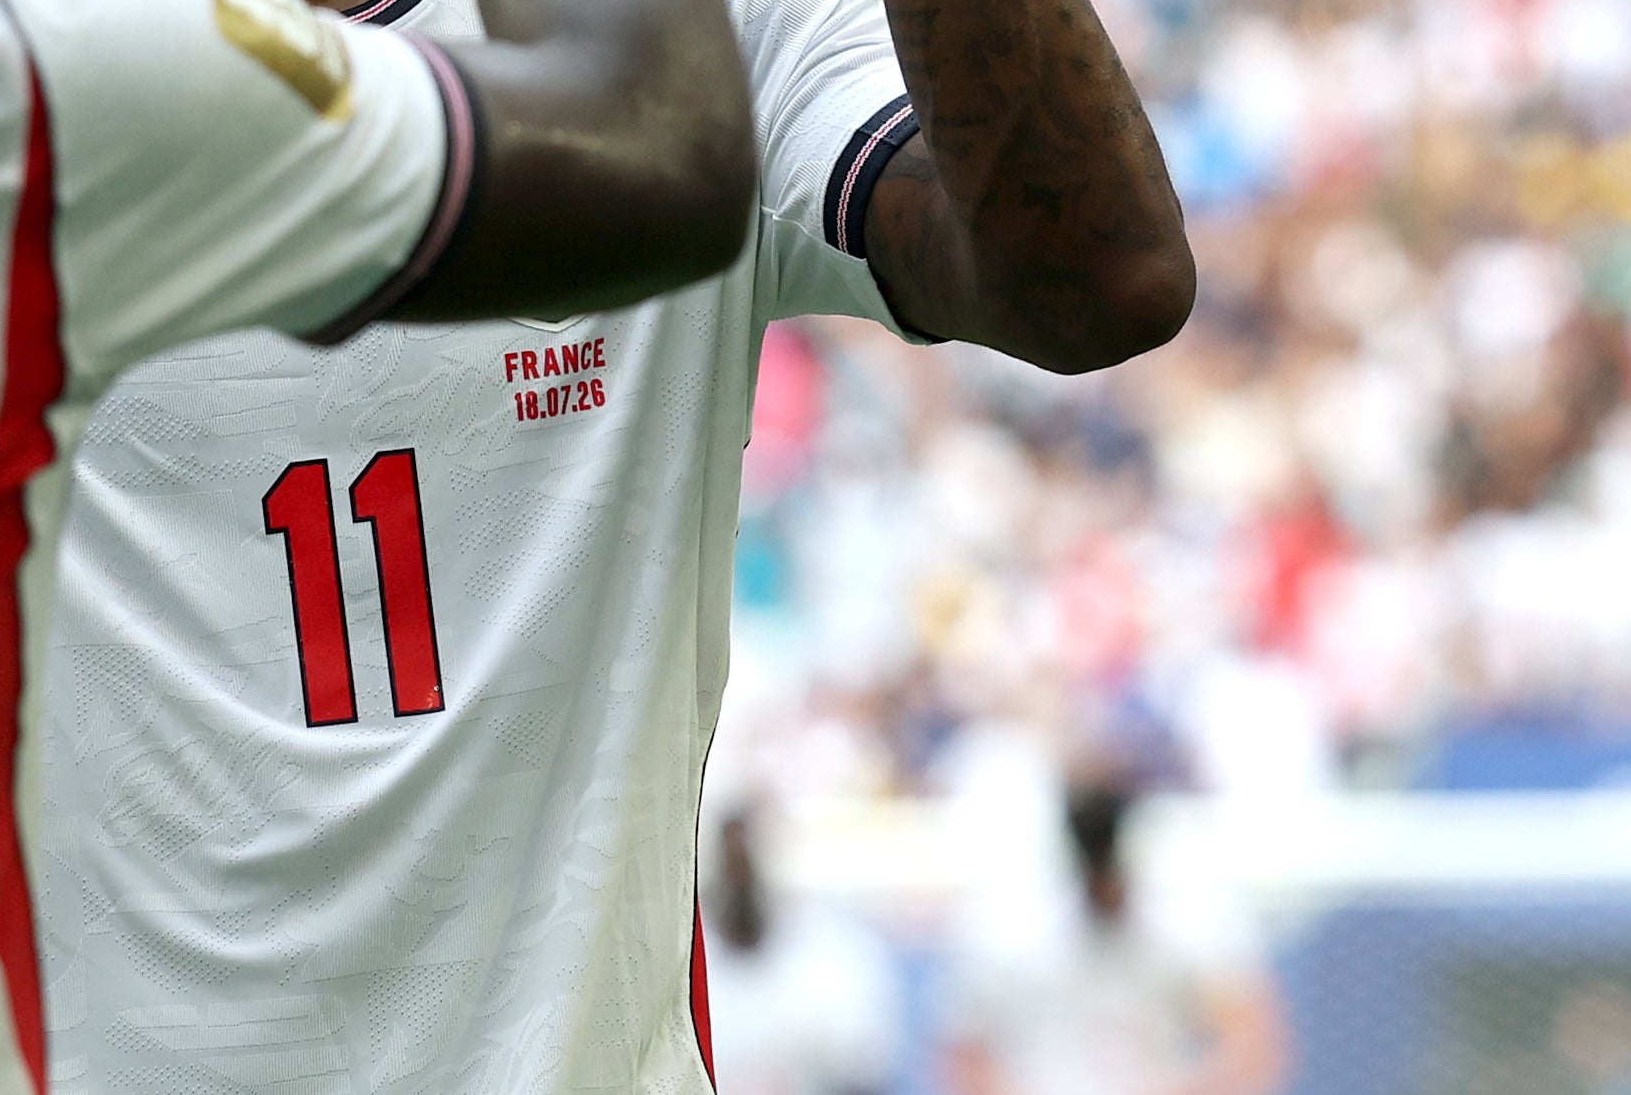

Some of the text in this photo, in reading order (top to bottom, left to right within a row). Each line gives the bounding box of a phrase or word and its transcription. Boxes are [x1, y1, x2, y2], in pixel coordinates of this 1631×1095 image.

[504, 337, 606, 383] FRANCE
[514, 378, 606, 421] 18.07.26
[262, 448, 445, 728] 11
